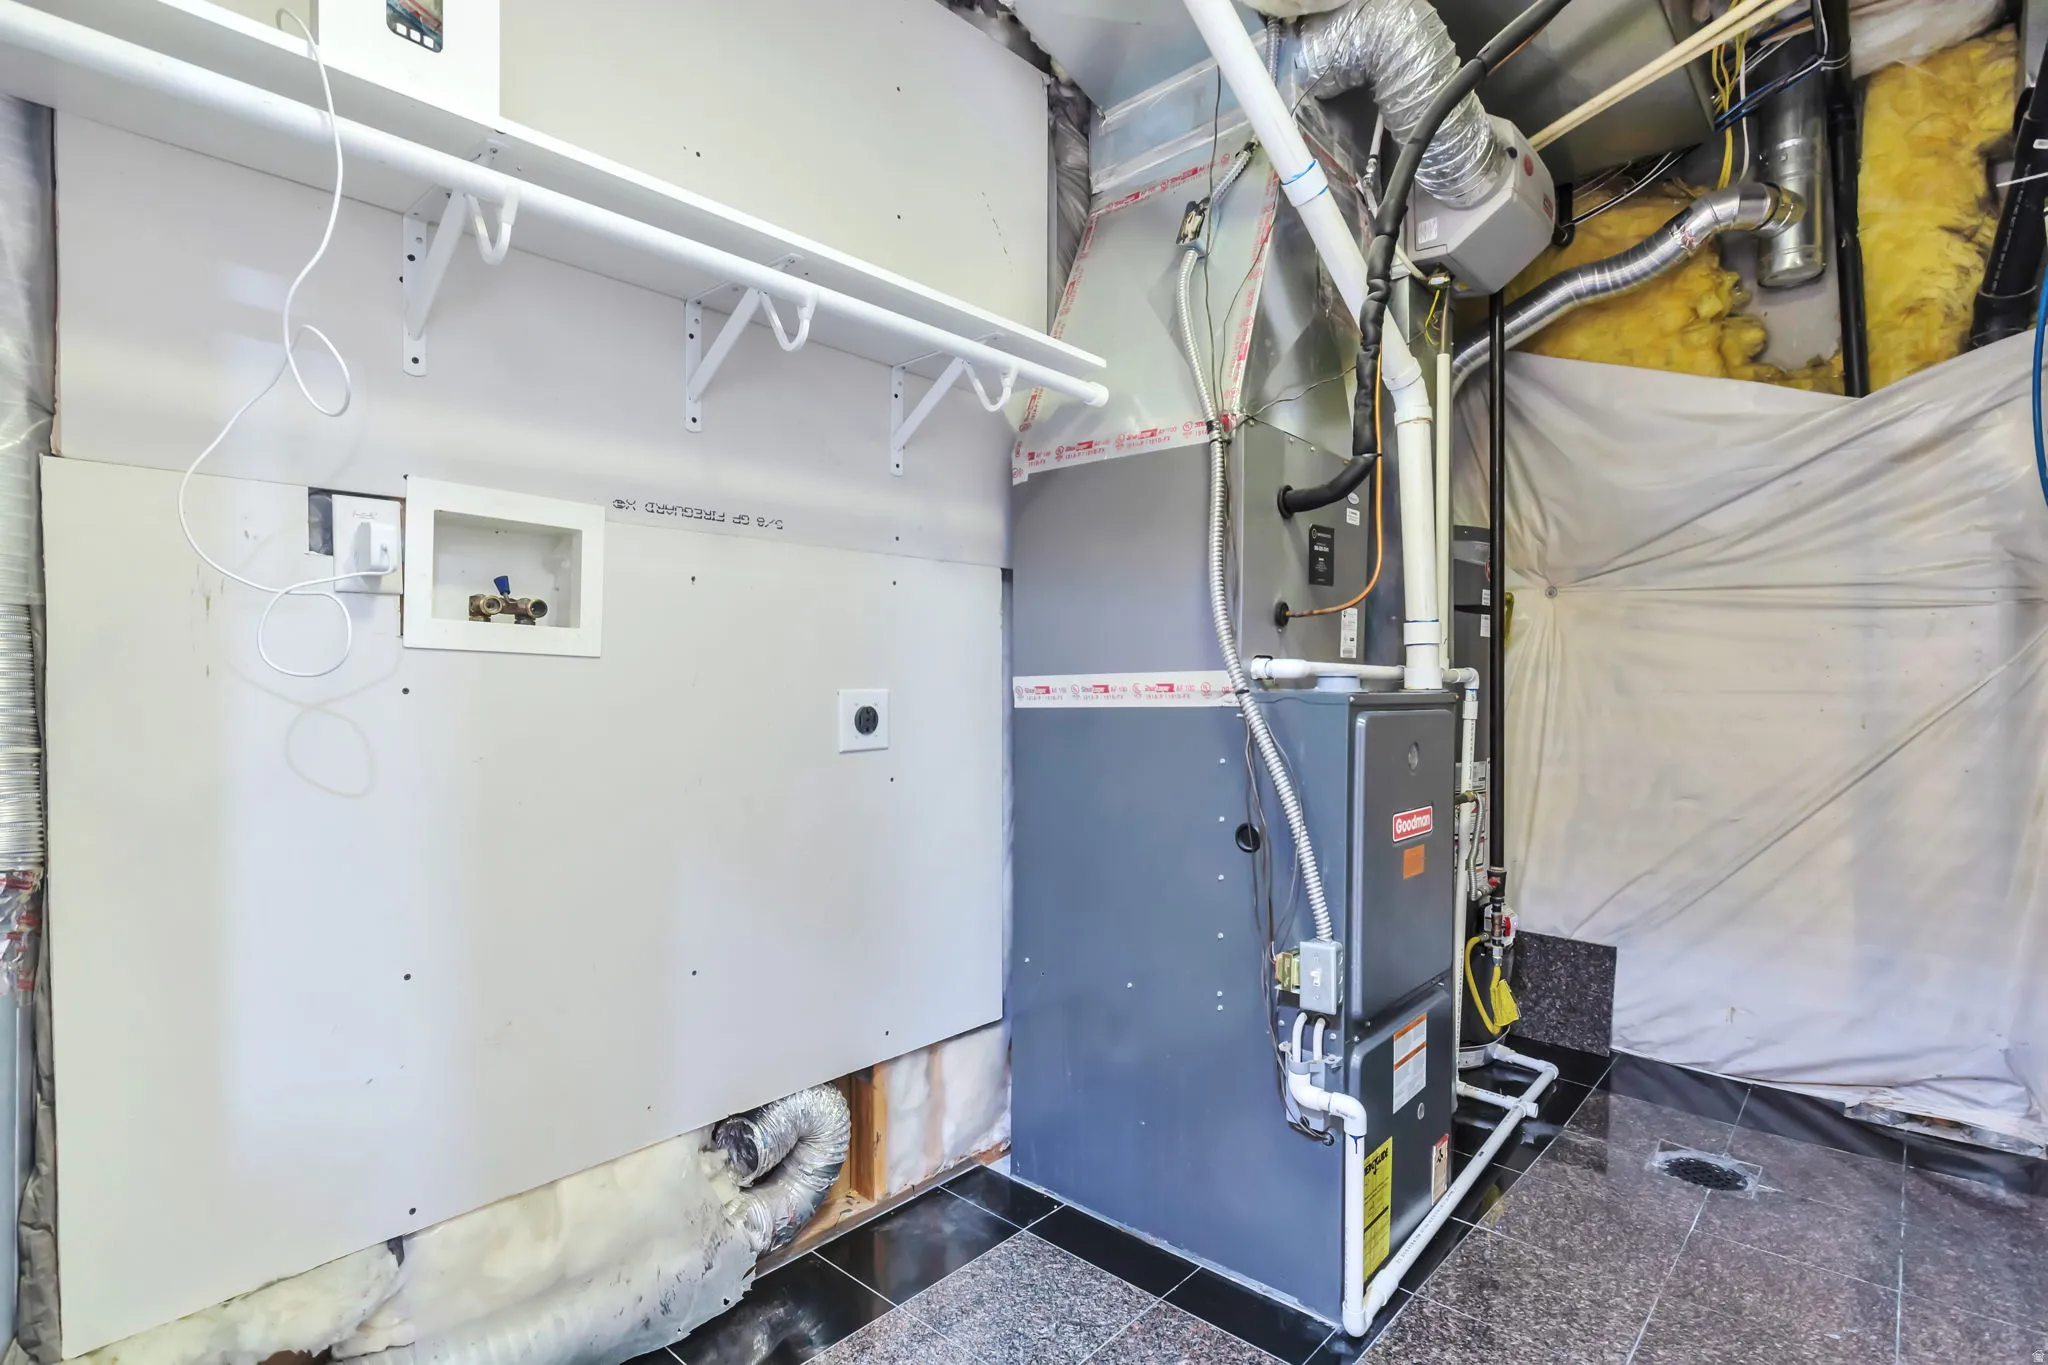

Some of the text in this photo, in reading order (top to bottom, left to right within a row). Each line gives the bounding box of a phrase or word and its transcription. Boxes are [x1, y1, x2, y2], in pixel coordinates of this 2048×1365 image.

[644, 501, 725, 522] FIREGUARD
[732, 514, 750, 526] GP
[756, 516, 784, 530] 5/8
[1395, 814, 1431, 834] Goodman
